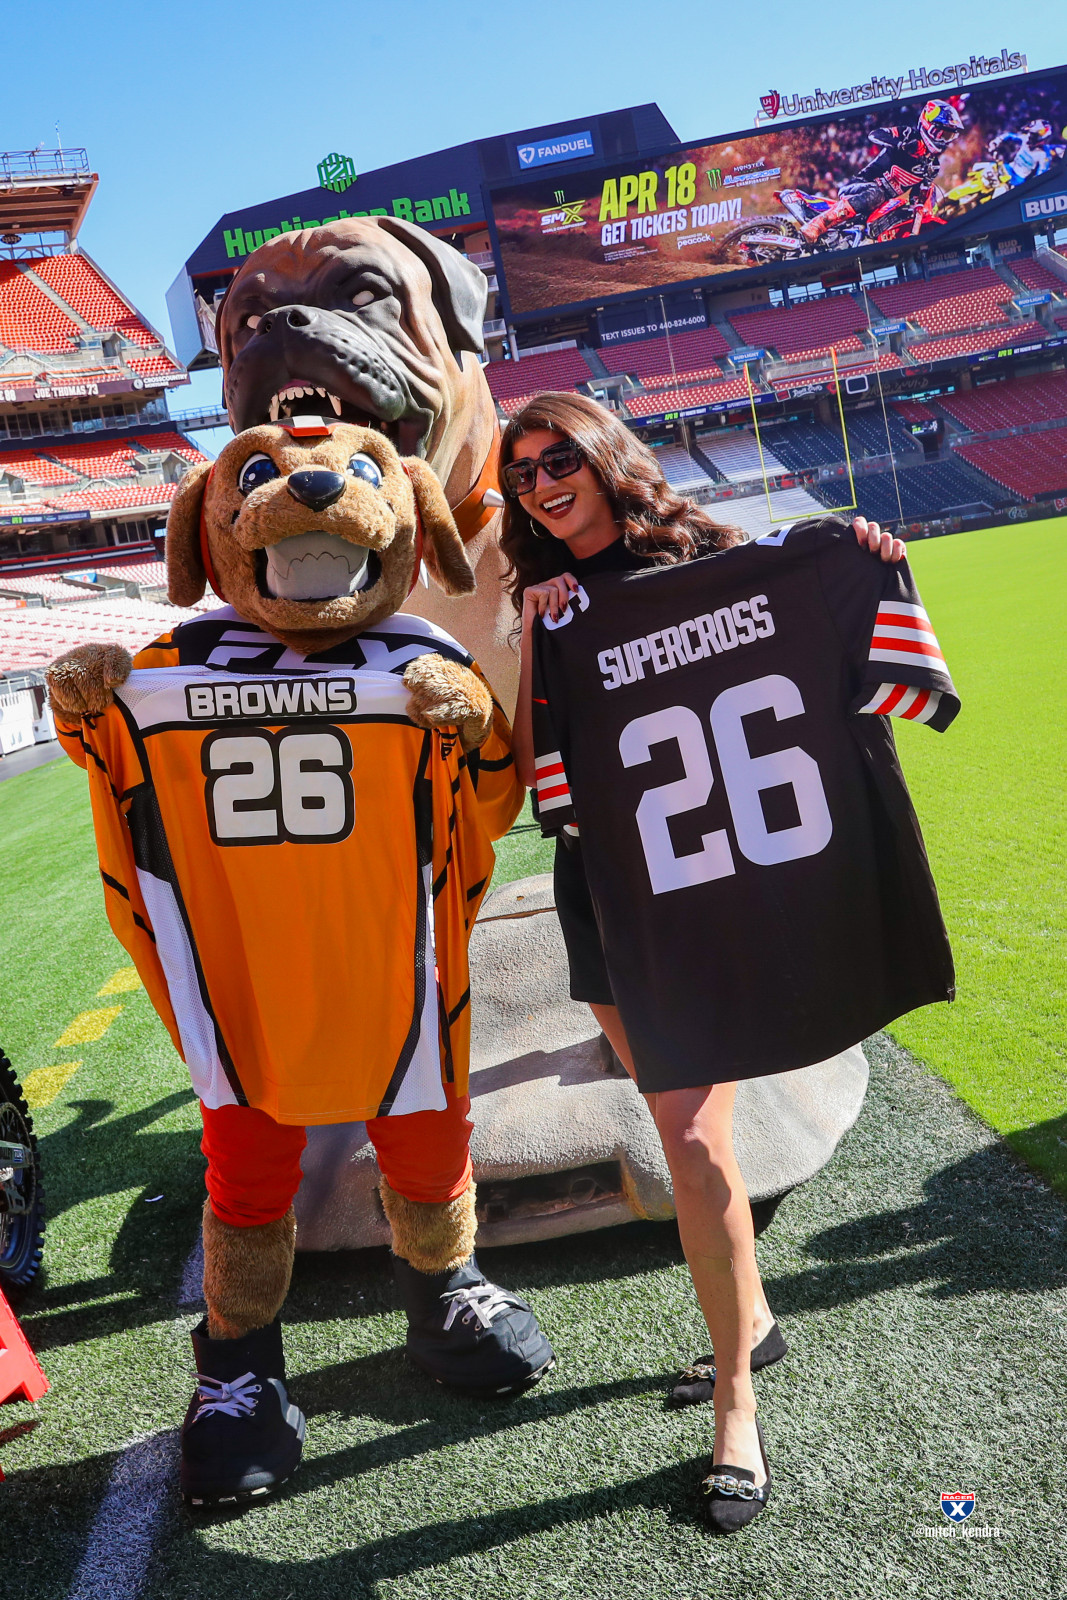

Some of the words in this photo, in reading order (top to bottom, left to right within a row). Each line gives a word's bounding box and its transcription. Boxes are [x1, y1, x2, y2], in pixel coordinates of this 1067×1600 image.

[781, 75, 903, 116] University
[908, 49, 1022, 90] Hospitals
[538, 137, 593, 159] FANDUEL
[392, 188, 471, 225] Bank
[598, 170, 658, 223] APR
[664, 162, 697, 208] 18
[1025, 195, 1067, 218] BUD
[601, 220, 628, 247] GET
[630, 208, 688, 241] TICKETS
[690, 197, 742, 228] TODAY!
[677, 233, 711, 250] peacock
[998, 239, 1018, 249] BUD
[601, 330, 620, 342] TEXT
[620, 326, 646, 338] ISSUES
[646, 324, 658, 333] TO
[659, 315, 706, 330] 440-824-6000
[34, 387, 51, 399] JOE
[51, 385, 87, 398] THOMAS
[86, 383, 99, 396] 73
[597, 594, 776, 691] SUPERCROSS
[187, 680, 354, 718] BROWNS
[208, 732, 346, 839] 26
[618, 674, 833, 896] 26
